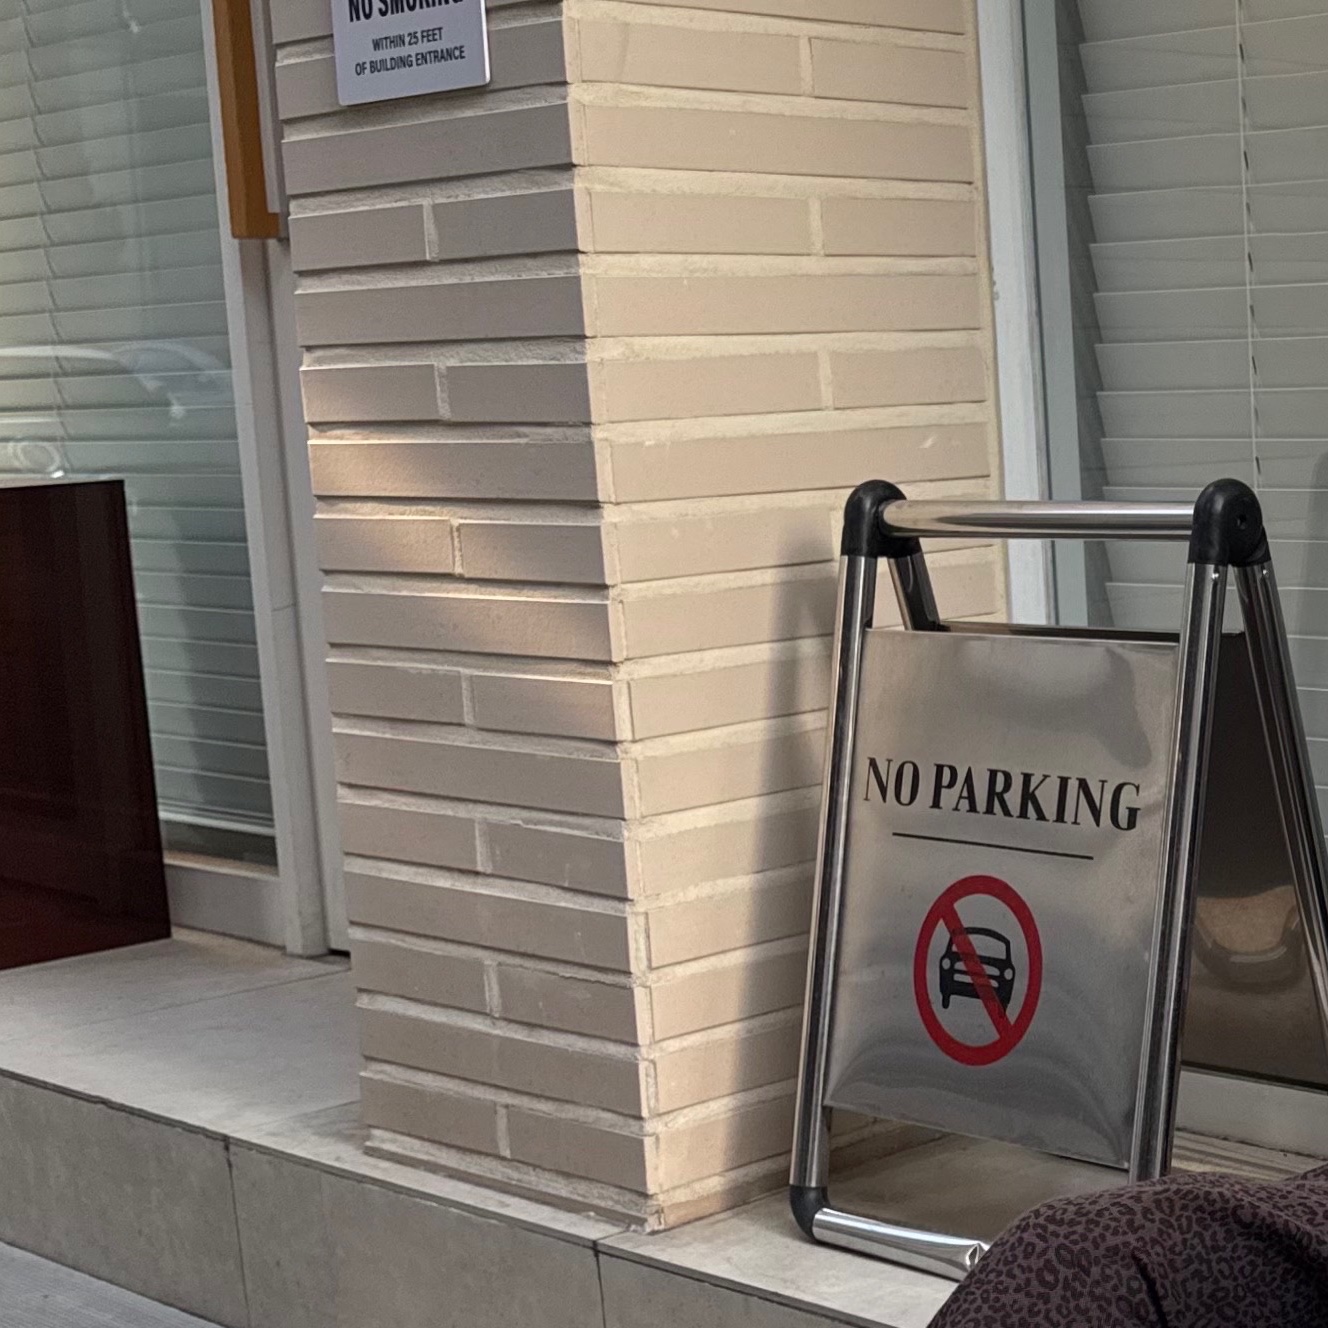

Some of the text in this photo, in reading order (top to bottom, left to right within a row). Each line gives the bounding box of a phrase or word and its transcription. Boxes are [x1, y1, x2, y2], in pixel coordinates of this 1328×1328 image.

[349, 0, 373, 22] NO
[372, 27, 443, 51] WITHIN 25 FEET
[355, 45, 466, 76] OF BUILDING ENTRANCE
[863, 757, 1142, 831] NO PARKING
